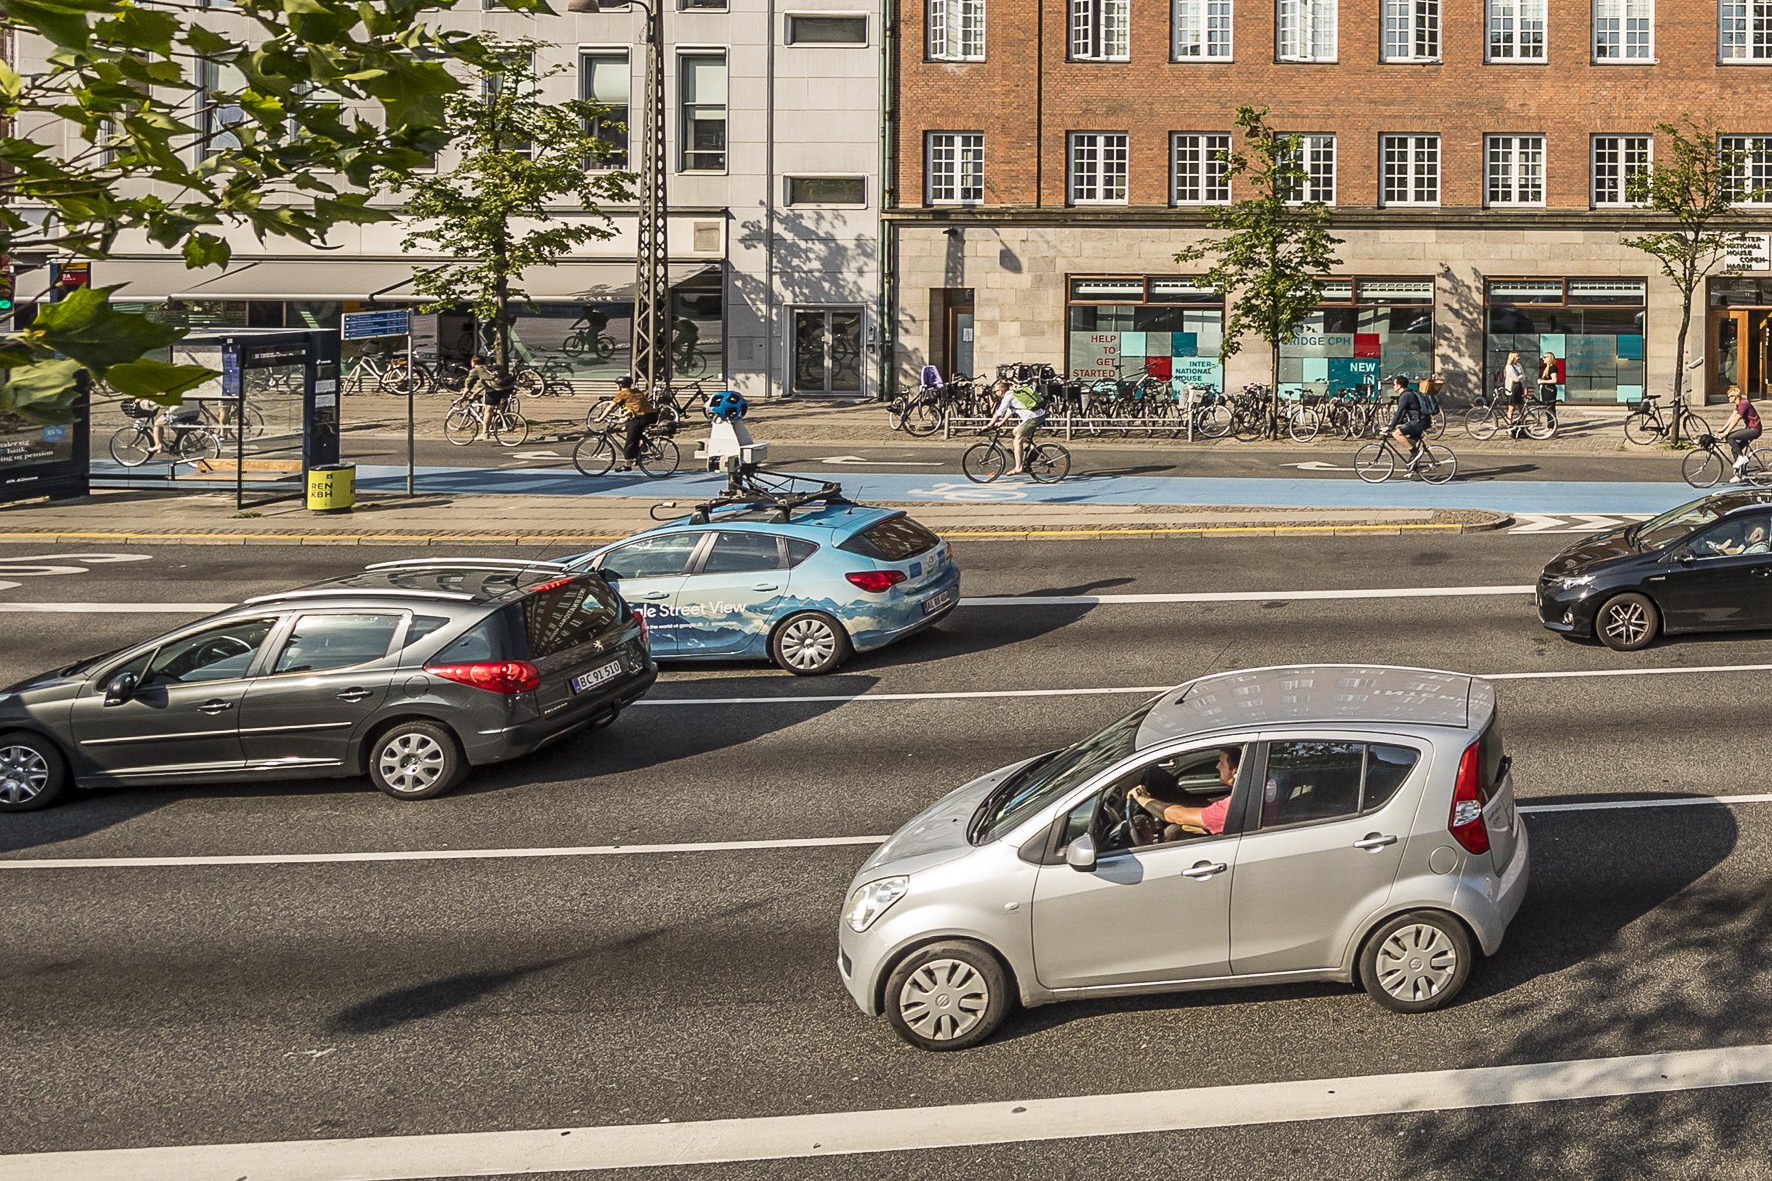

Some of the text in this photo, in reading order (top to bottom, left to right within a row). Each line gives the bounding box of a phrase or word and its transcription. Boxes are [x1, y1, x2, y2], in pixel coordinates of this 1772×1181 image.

[1090, 334, 1117, 343] HELP
[1281, 336, 1352, 346] RIDGE CPH
[1103, 346, 1117, 355] TO
[1096, 357, 1116, 366] GET
[1350, 362, 1376, 372] NEW
[1072, 369, 1116, 378] STARTED
[1363, 375, 1375, 385] IN
[25, 449, 54, 460] pension
[311, 482, 333, 490] REN
[311, 491, 333, 499] KBH
[660, 602, 707, 617] Street
[709, 600, 747, 614] View
[579, 674, 594, 688] BC
[592, 671, 605, 684] 91
[604, 662, 621, 677] 510
